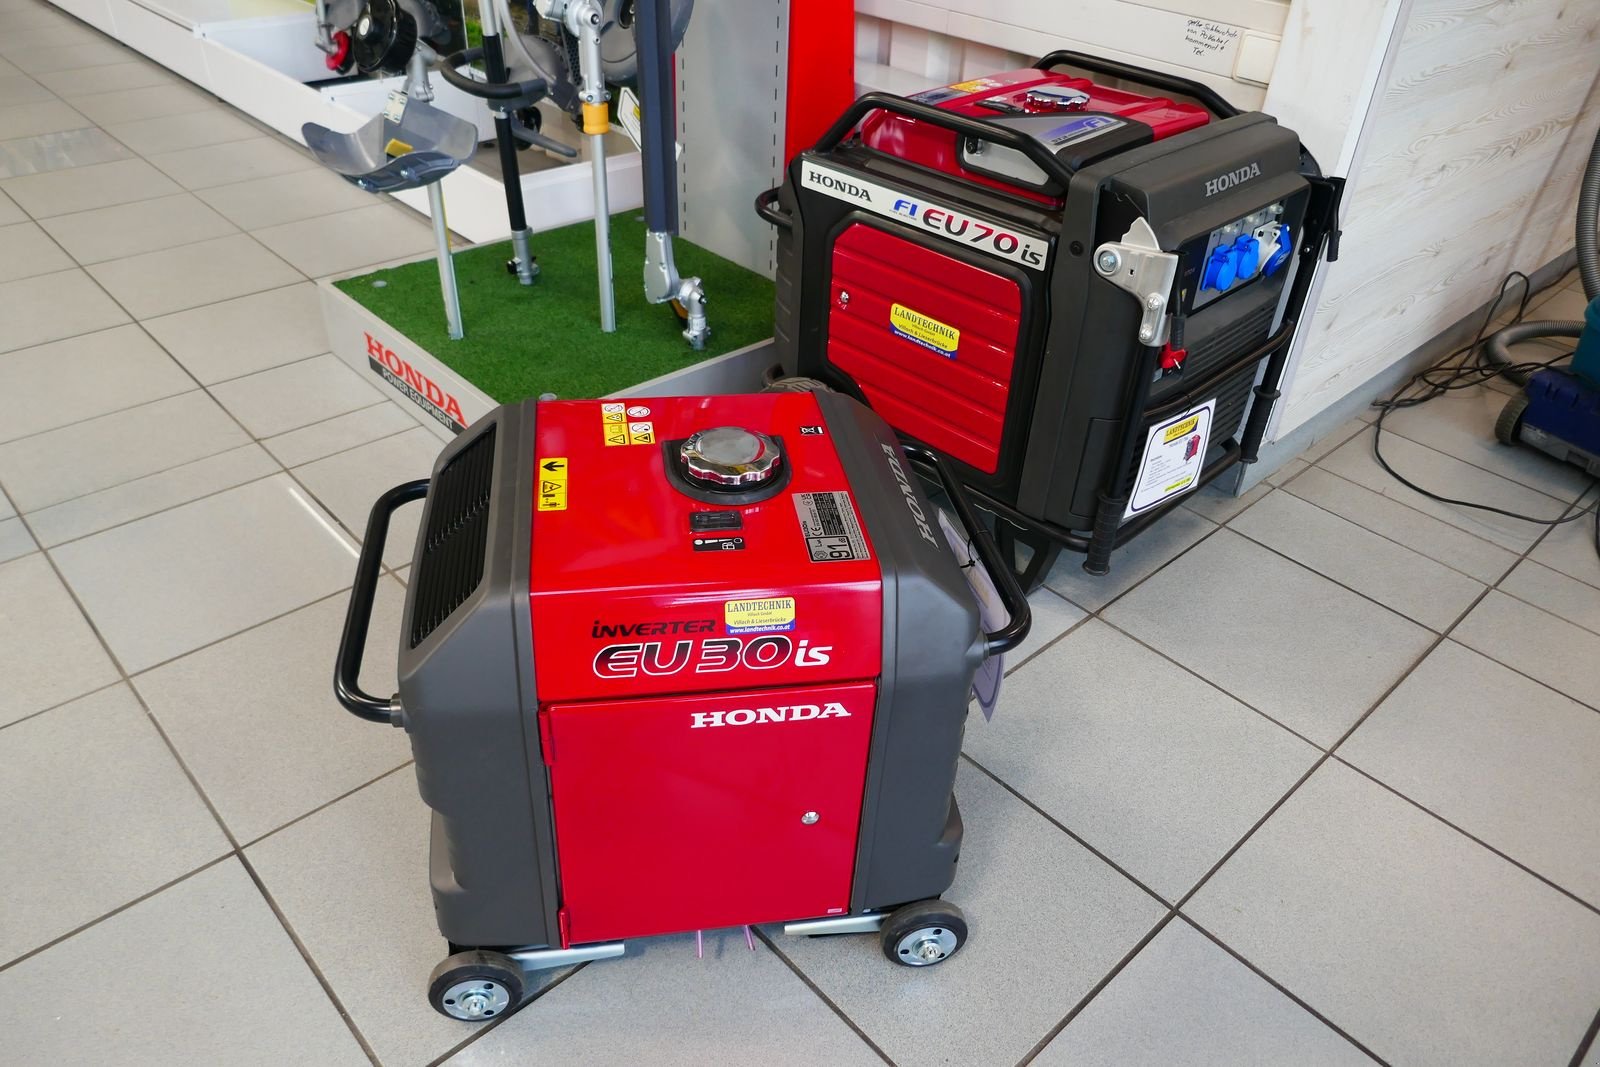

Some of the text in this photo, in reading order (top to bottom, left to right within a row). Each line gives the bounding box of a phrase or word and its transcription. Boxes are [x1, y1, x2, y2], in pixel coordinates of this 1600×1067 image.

[808, 170, 872, 203] HONDA
[894, 199, 918, 216] FI
[1205, 162, 1261, 197] HONDA
[894, 307, 955, 340] LANDTECHNIK
[893, 330, 951, 358] www.landtechnik.co.at
[364, 331, 468, 430] HONDA
[382, 367, 454, 429] POWER EQUIPMENT
[881, 443, 940, 553] HONDA
[827, 544, 850, 558] 91
[727, 600, 792, 612] LANDTECHNIK
[729, 624, 791, 633] www.landtechnik.co.at
[690, 702, 852, 729] HONDA
